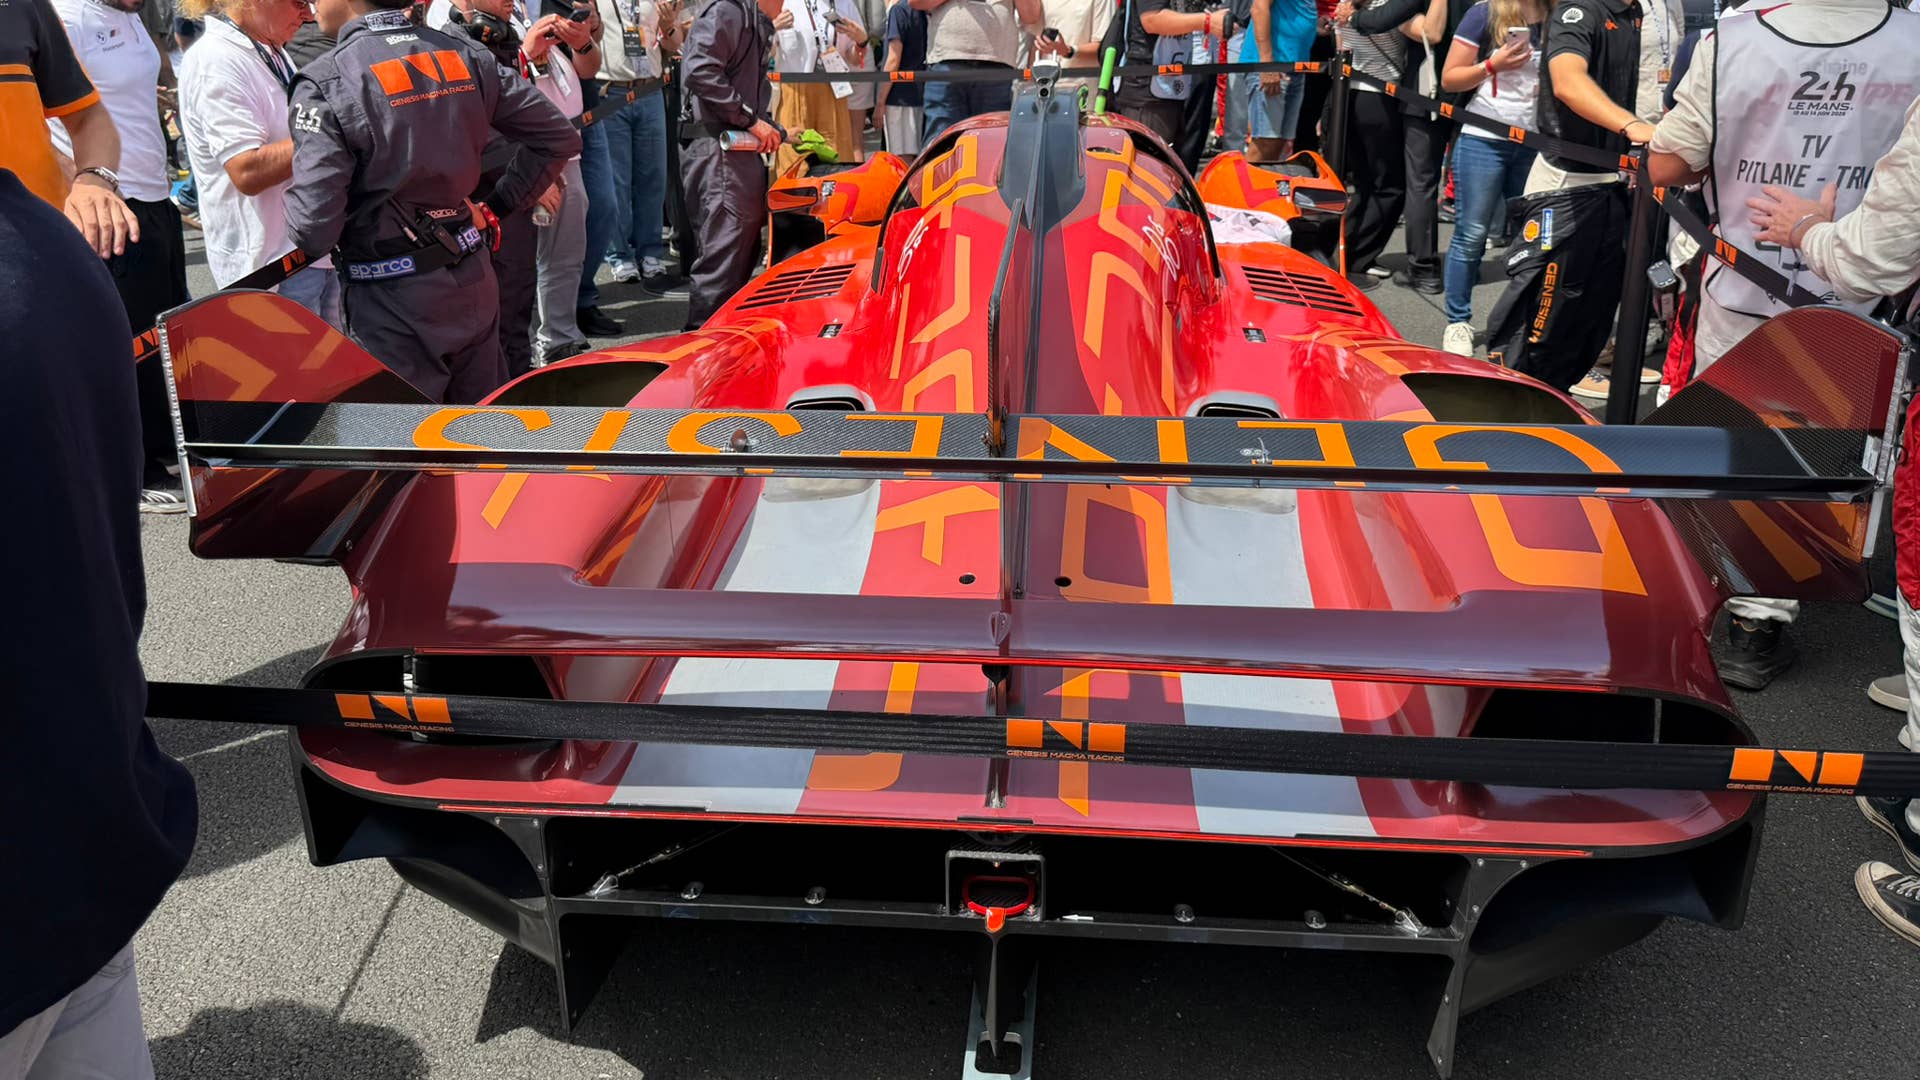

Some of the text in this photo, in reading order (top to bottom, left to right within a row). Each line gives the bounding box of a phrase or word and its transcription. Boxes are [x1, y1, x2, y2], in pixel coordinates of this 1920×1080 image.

[389, 94, 419, 107] GENESIS
[449, 83, 476, 95] RACING
[1787, 102, 1806, 110] LE
[1801, 135, 1832, 158] TV
[1736, 158, 1812, 188] PITLANE
[350, 256, 413, 279] sparco
[1533, 262, 1558, 329] GENESIS
[344, 721, 455, 733] GENESIS MAGMA RACING
[1006, 749, 1125, 762] GENESIS MAGMA RACING
[1726, 783, 1855, 795] GENESIS MAGMA RACING
